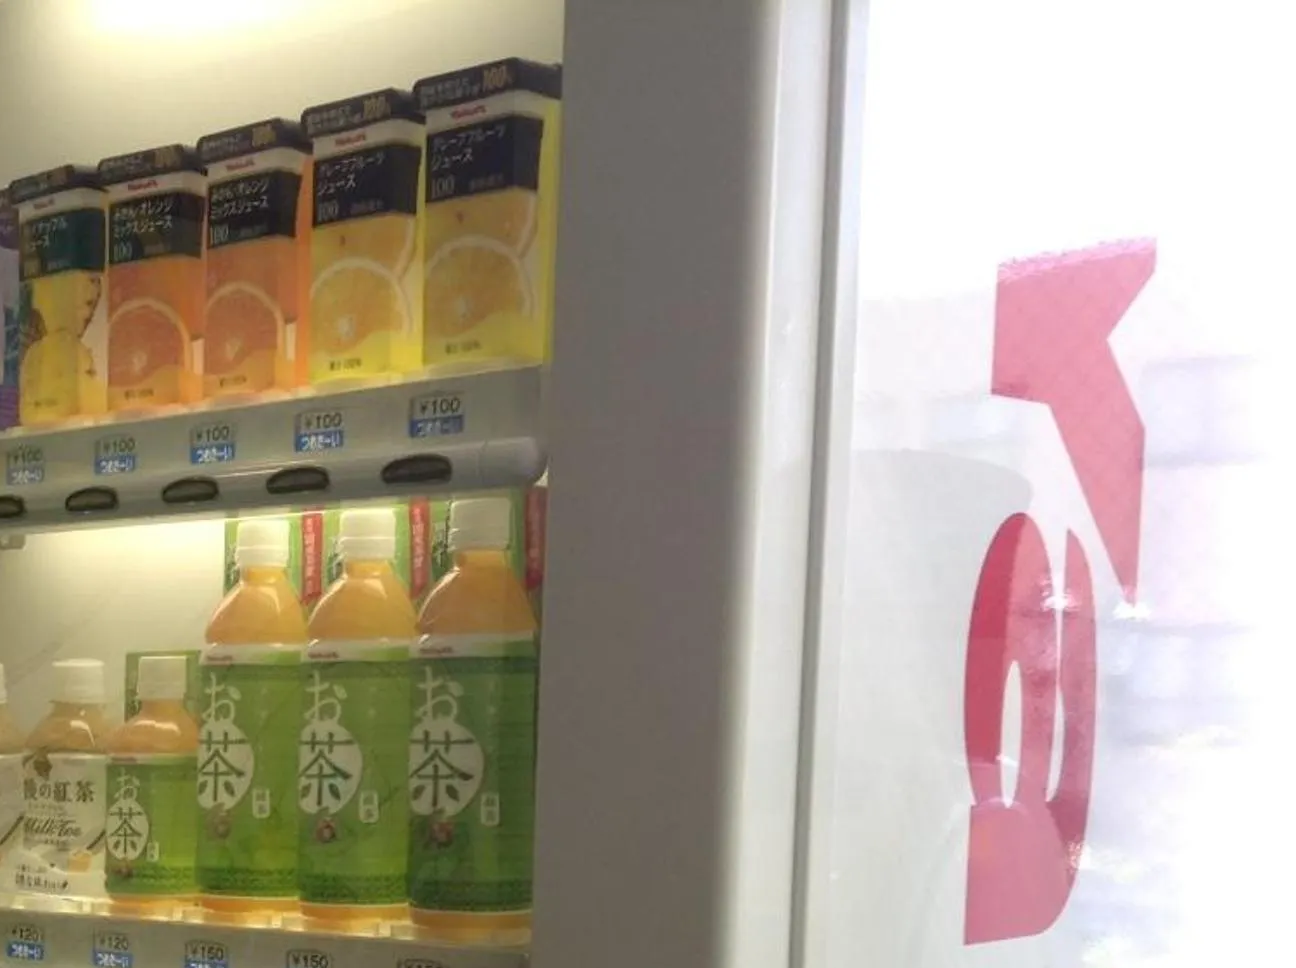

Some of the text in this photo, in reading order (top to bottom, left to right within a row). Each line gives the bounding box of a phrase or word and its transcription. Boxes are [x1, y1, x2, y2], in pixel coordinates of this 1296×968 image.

[420, 398, 460, 414] ¥100
[305, 413, 342, 428] ¥100
[196, 426, 229, 441] ¥100
[104, 439, 135, 453] ¥100
[198, 673, 246, 802] お茶
[300, 671, 351, 805] お茶
[410, 666, 473, 806] お茶
[108, 768, 143, 855] お茶
[100, 934, 129, 950] ¥120
[191, 946, 224, 962] ¥150
